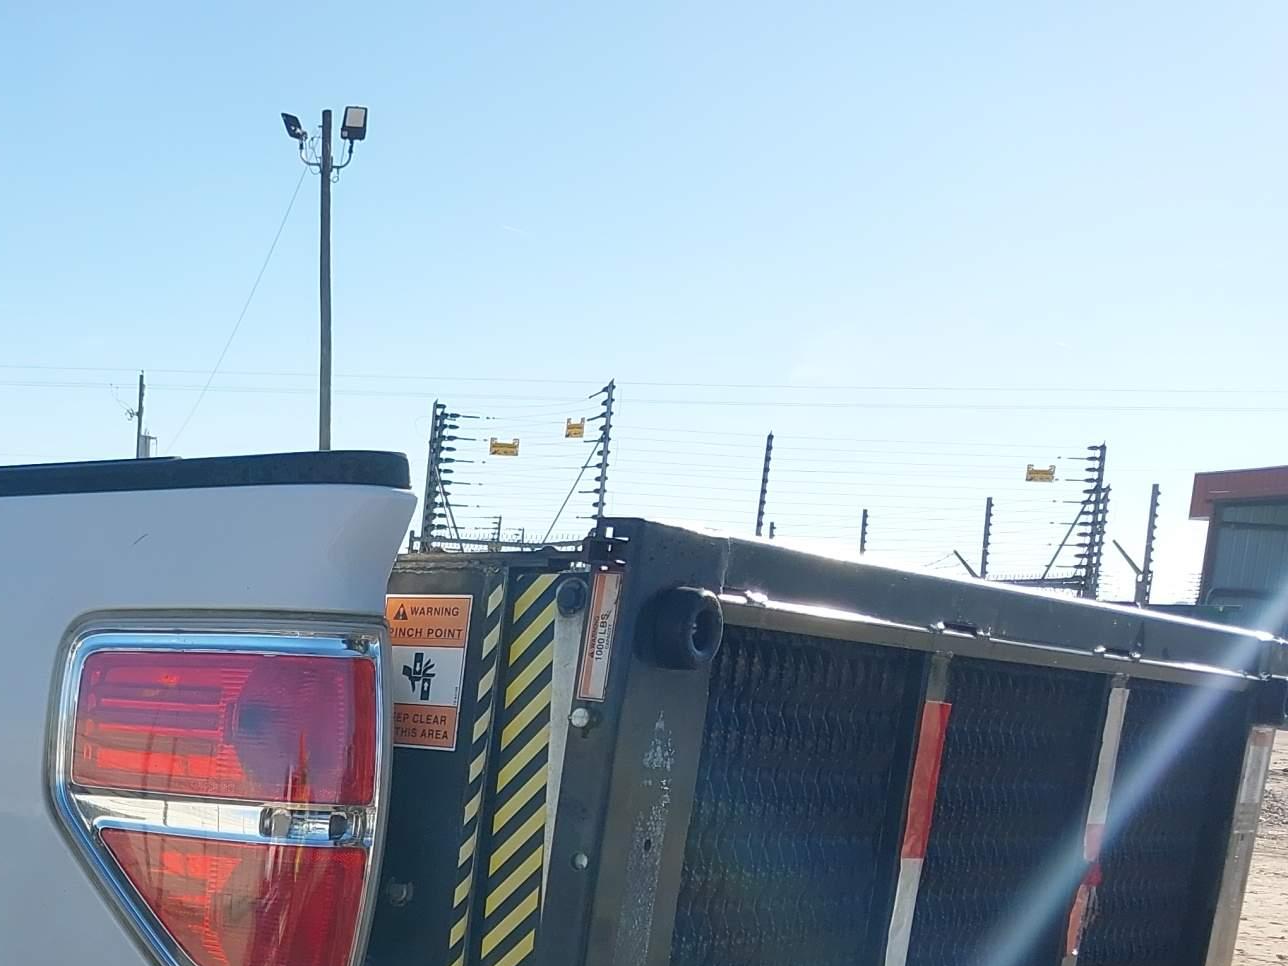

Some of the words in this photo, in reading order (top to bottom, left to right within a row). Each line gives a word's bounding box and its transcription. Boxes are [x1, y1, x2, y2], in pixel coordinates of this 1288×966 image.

[410, 606, 460, 617] WARNING
[598, 610, 609, 635] LBS.
[427, 628, 463, 639] POINT
[595, 638, 605, 661] 1000
[412, 713, 447, 726] CLEAR
[394, 727, 417, 738] THIS
[420, 729, 449, 740] AREA
